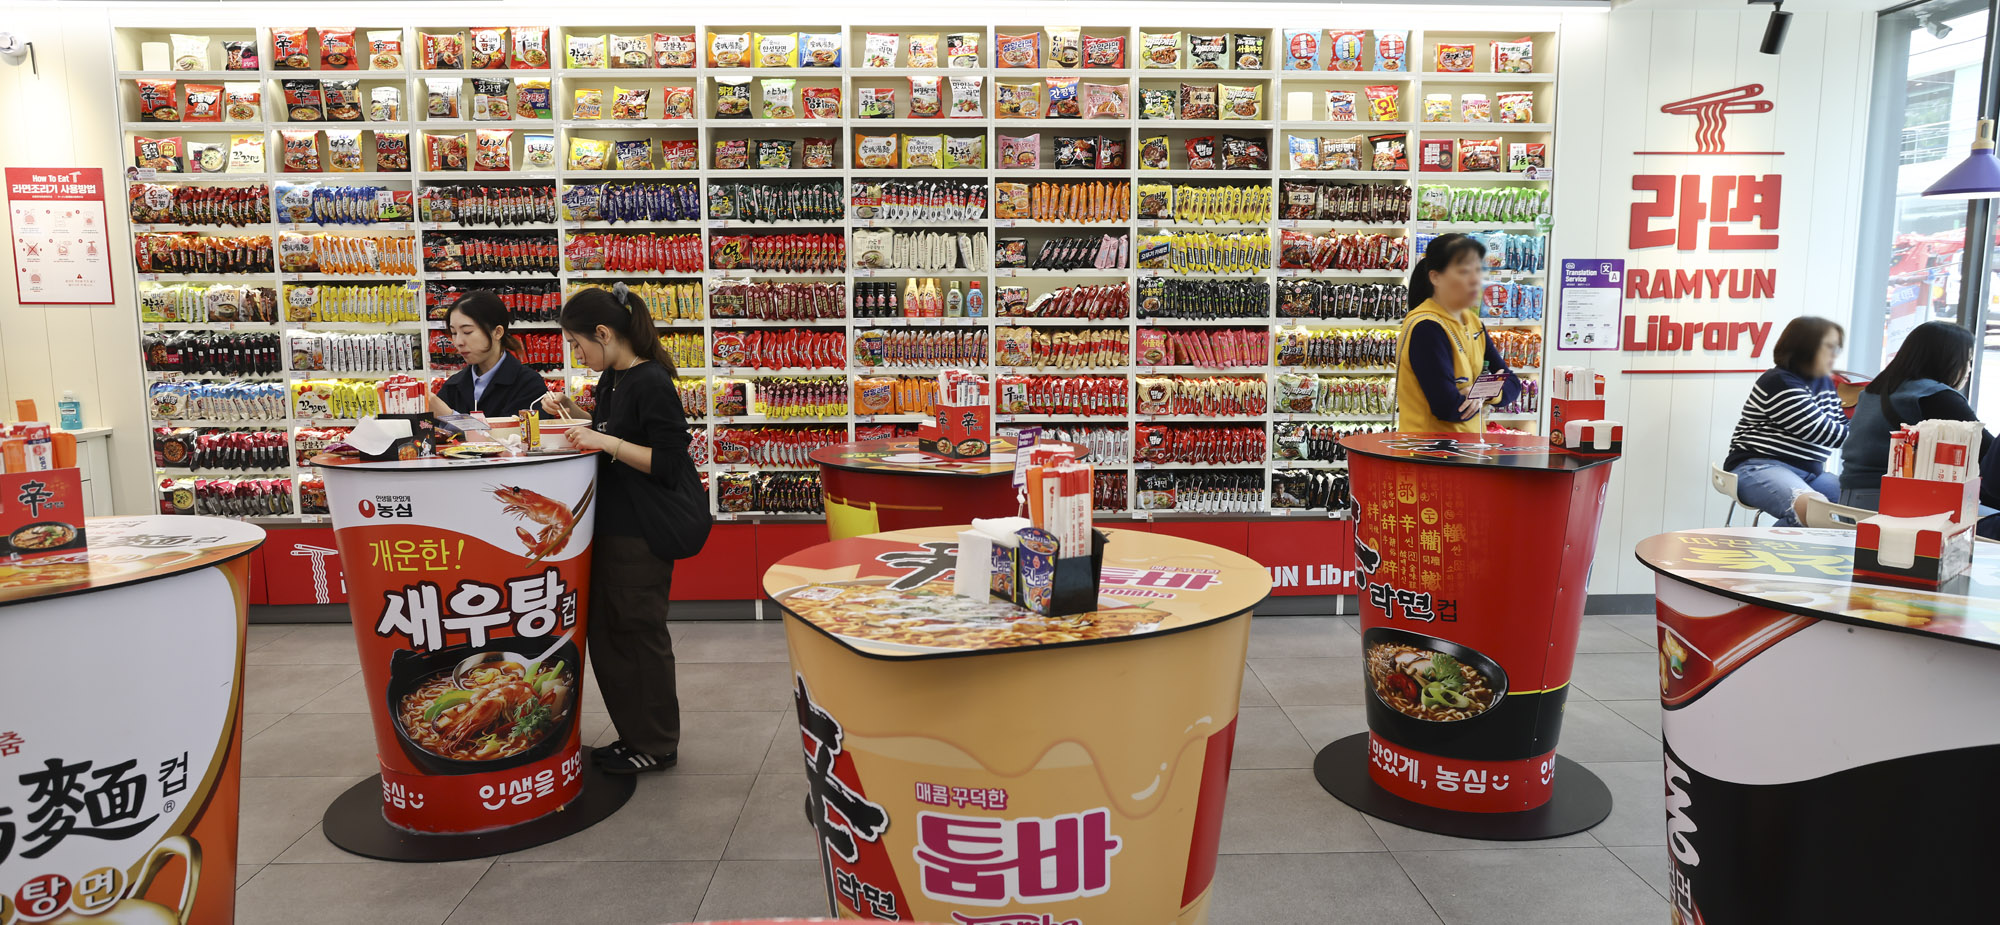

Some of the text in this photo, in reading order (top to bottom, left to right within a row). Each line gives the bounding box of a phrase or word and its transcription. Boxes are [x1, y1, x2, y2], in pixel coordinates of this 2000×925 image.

[276, 35, 292, 57] 辛
[324, 34, 339, 53] 辛
[762, 45, 787, 53] 안성탕면
[141, 86, 159, 109] 辛
[478, 84, 501, 93] 감자면
[287, 139, 313, 149] 너구리
[330, 138, 356, 148] 너구리
[480, 138, 504, 147] 너구리
[910, 145, 934, 154] 안성탕면
[12, 184, 97, 194] 라면조리기 사용방법
[32, 175, 70, 183] How To Eat
[1629, 174, 1782, 250] 라면
[1626, 269, 1776, 299] RAMYUN
[437, 335, 452, 356] 辛
[1623, 315, 1773, 358] Library
[863, 385, 890, 397] 삼양라면
[961, 412, 978, 436] 辛
[18, 479, 54, 518] 辛
[377, 502, 413, 518] 농심
[1023, 566, 1050, 588] 진라면
[378, 570, 577, 652] 새우탕 컵
[1369, 582, 1457, 622] 라면 컵
[158, 751, 189, 798] 컵
[1372, 739, 1487, 794] 맛있게, 농심
[479, 769, 555, 811] 인생을
[915, 782, 1009, 811] 매콤 꾸덕한
[916, 810, 1119, 902] 툼바
